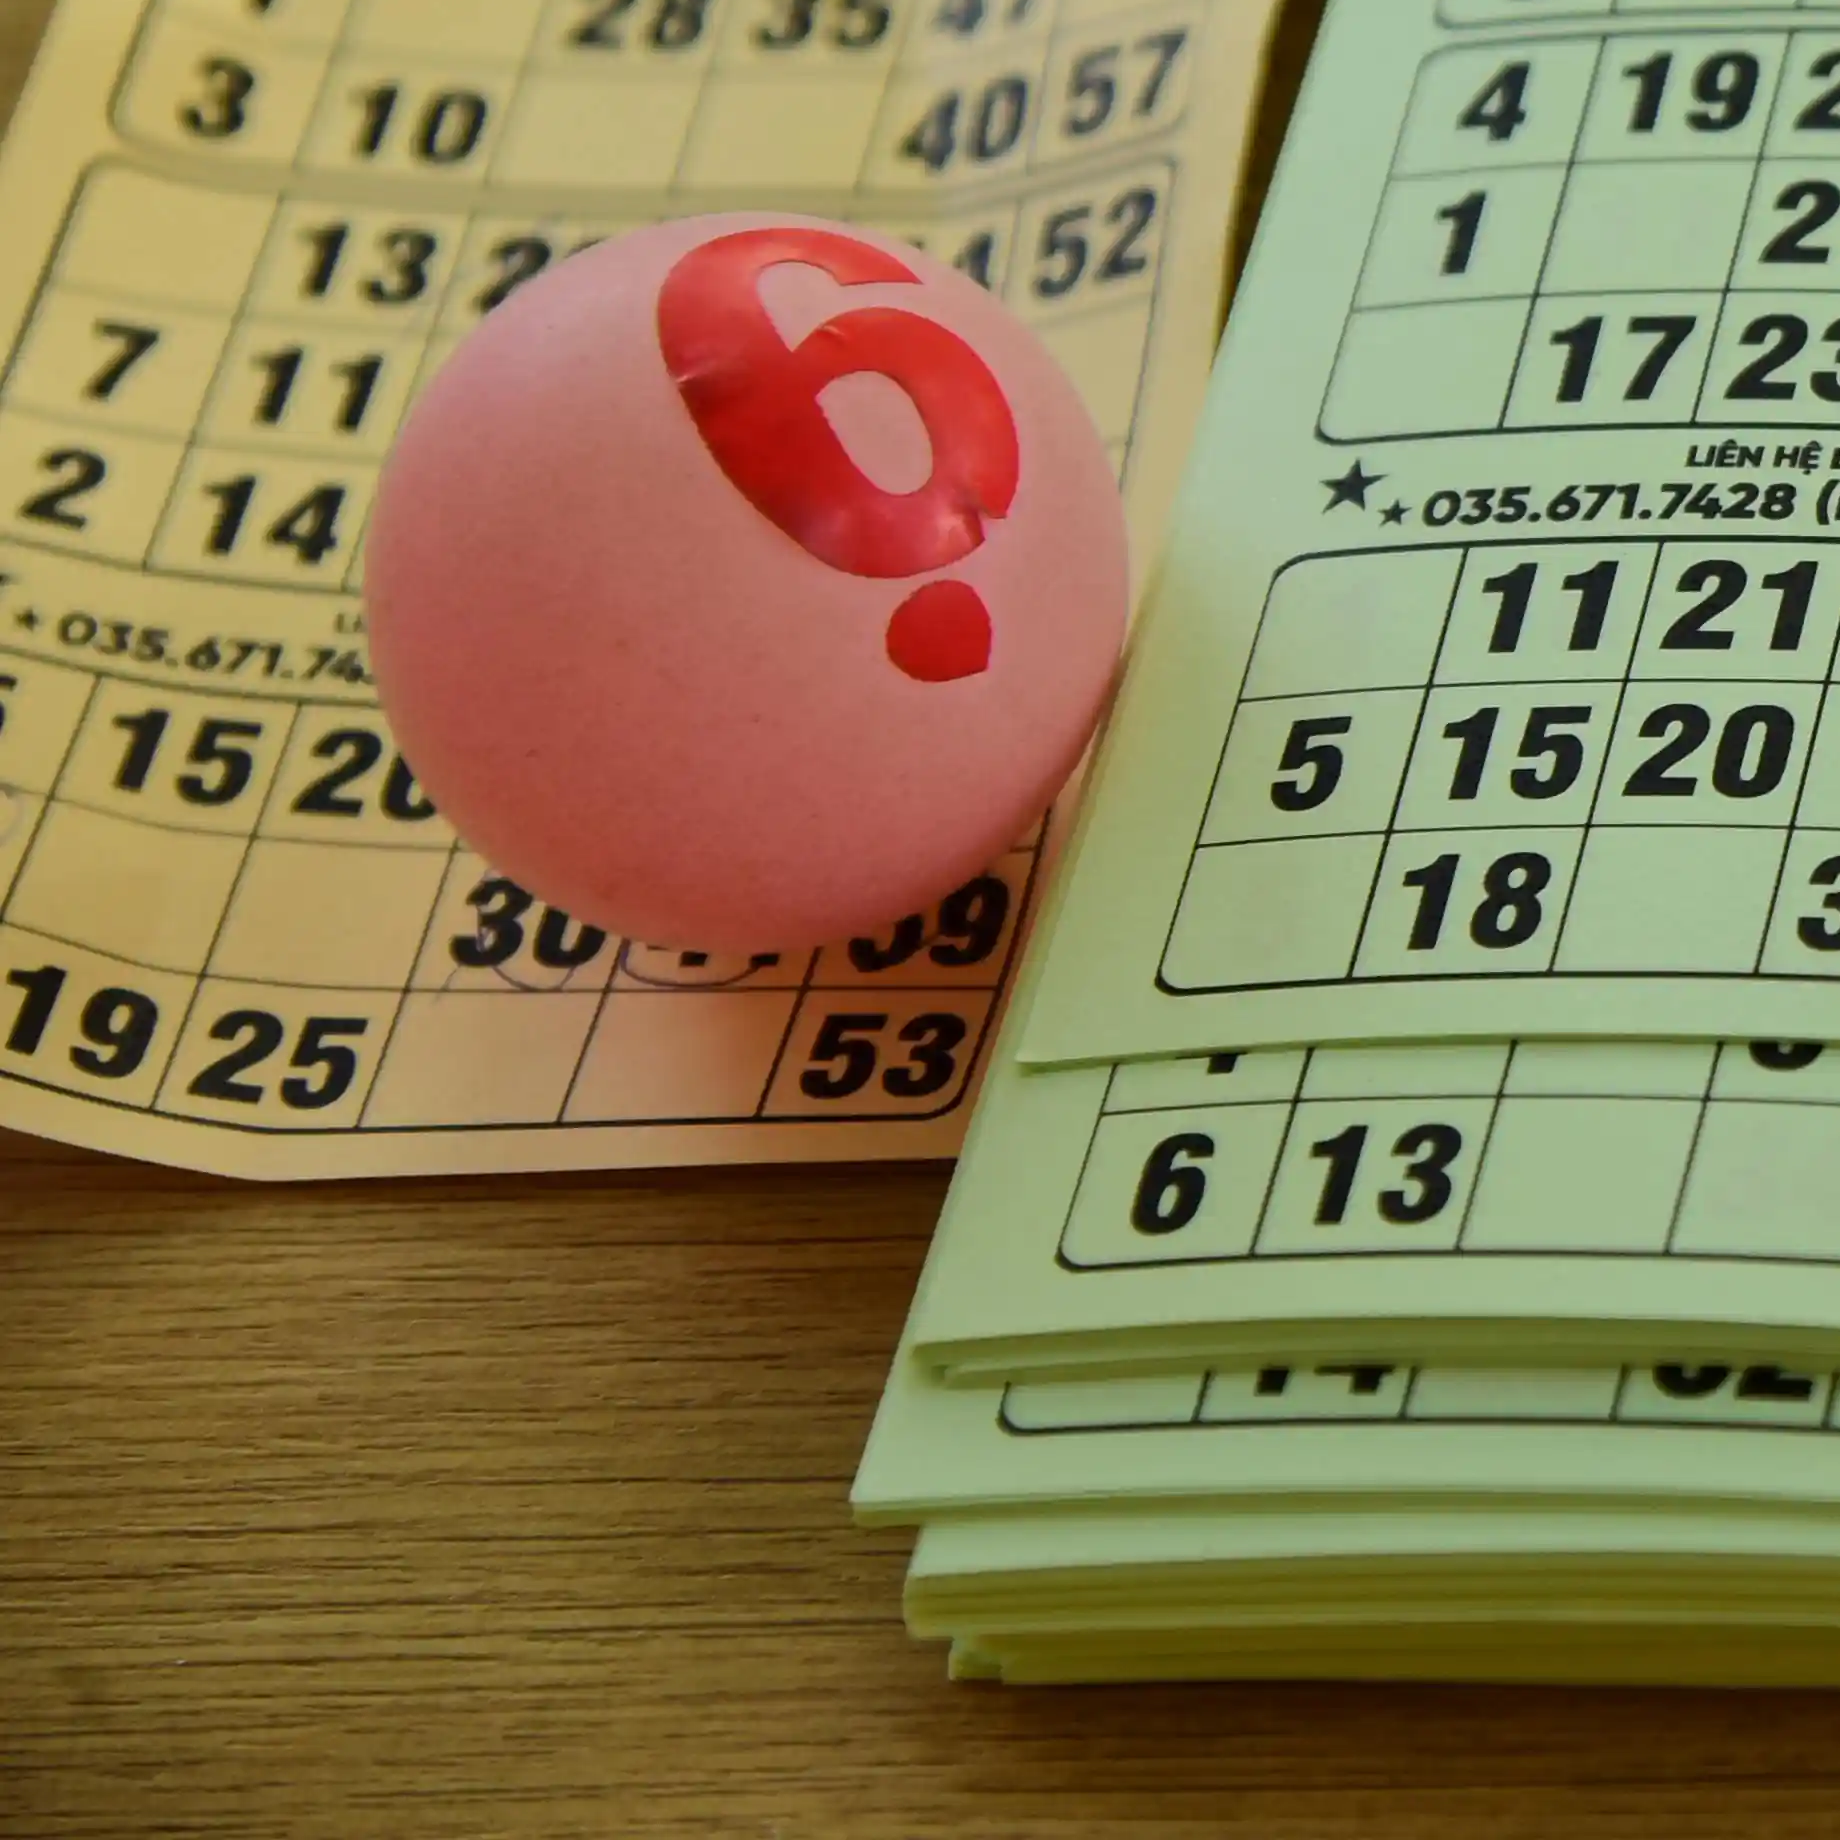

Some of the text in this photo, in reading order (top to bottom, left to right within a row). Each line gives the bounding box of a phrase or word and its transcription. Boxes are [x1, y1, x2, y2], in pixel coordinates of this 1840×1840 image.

[179, 27, 1188, 173] 3 10 40 57
[1458, 60, 1532, 143] 4
[1625, 50, 1761, 134] 19
[303, 186, 1159, 306] 13 52
[1436, 190, 1488, 276] 1
[85, 321, 385, 434] 7 11
[1549, 314, 1698, 404] 17
[19, 447, 347, 566] 2 14
[1422, 482, 1798, 527] 035.671.7428
[1685, 438, 1766, 469] LIÊN
[1772, 440, 1824, 476] HỆ
[112, 707, 264, 808] 15
[1269, 714, 1354, 813] 5
[1441, 704, 1594, 802] 15
[1621, 702, 1796, 800] 20
[1401, 850, 1553, 951] 18
[4, 964, 969, 1111] 19 25 53
[1129, 1131, 1216, 1237] 6
[1309, 1122, 1464, 1227] 13
